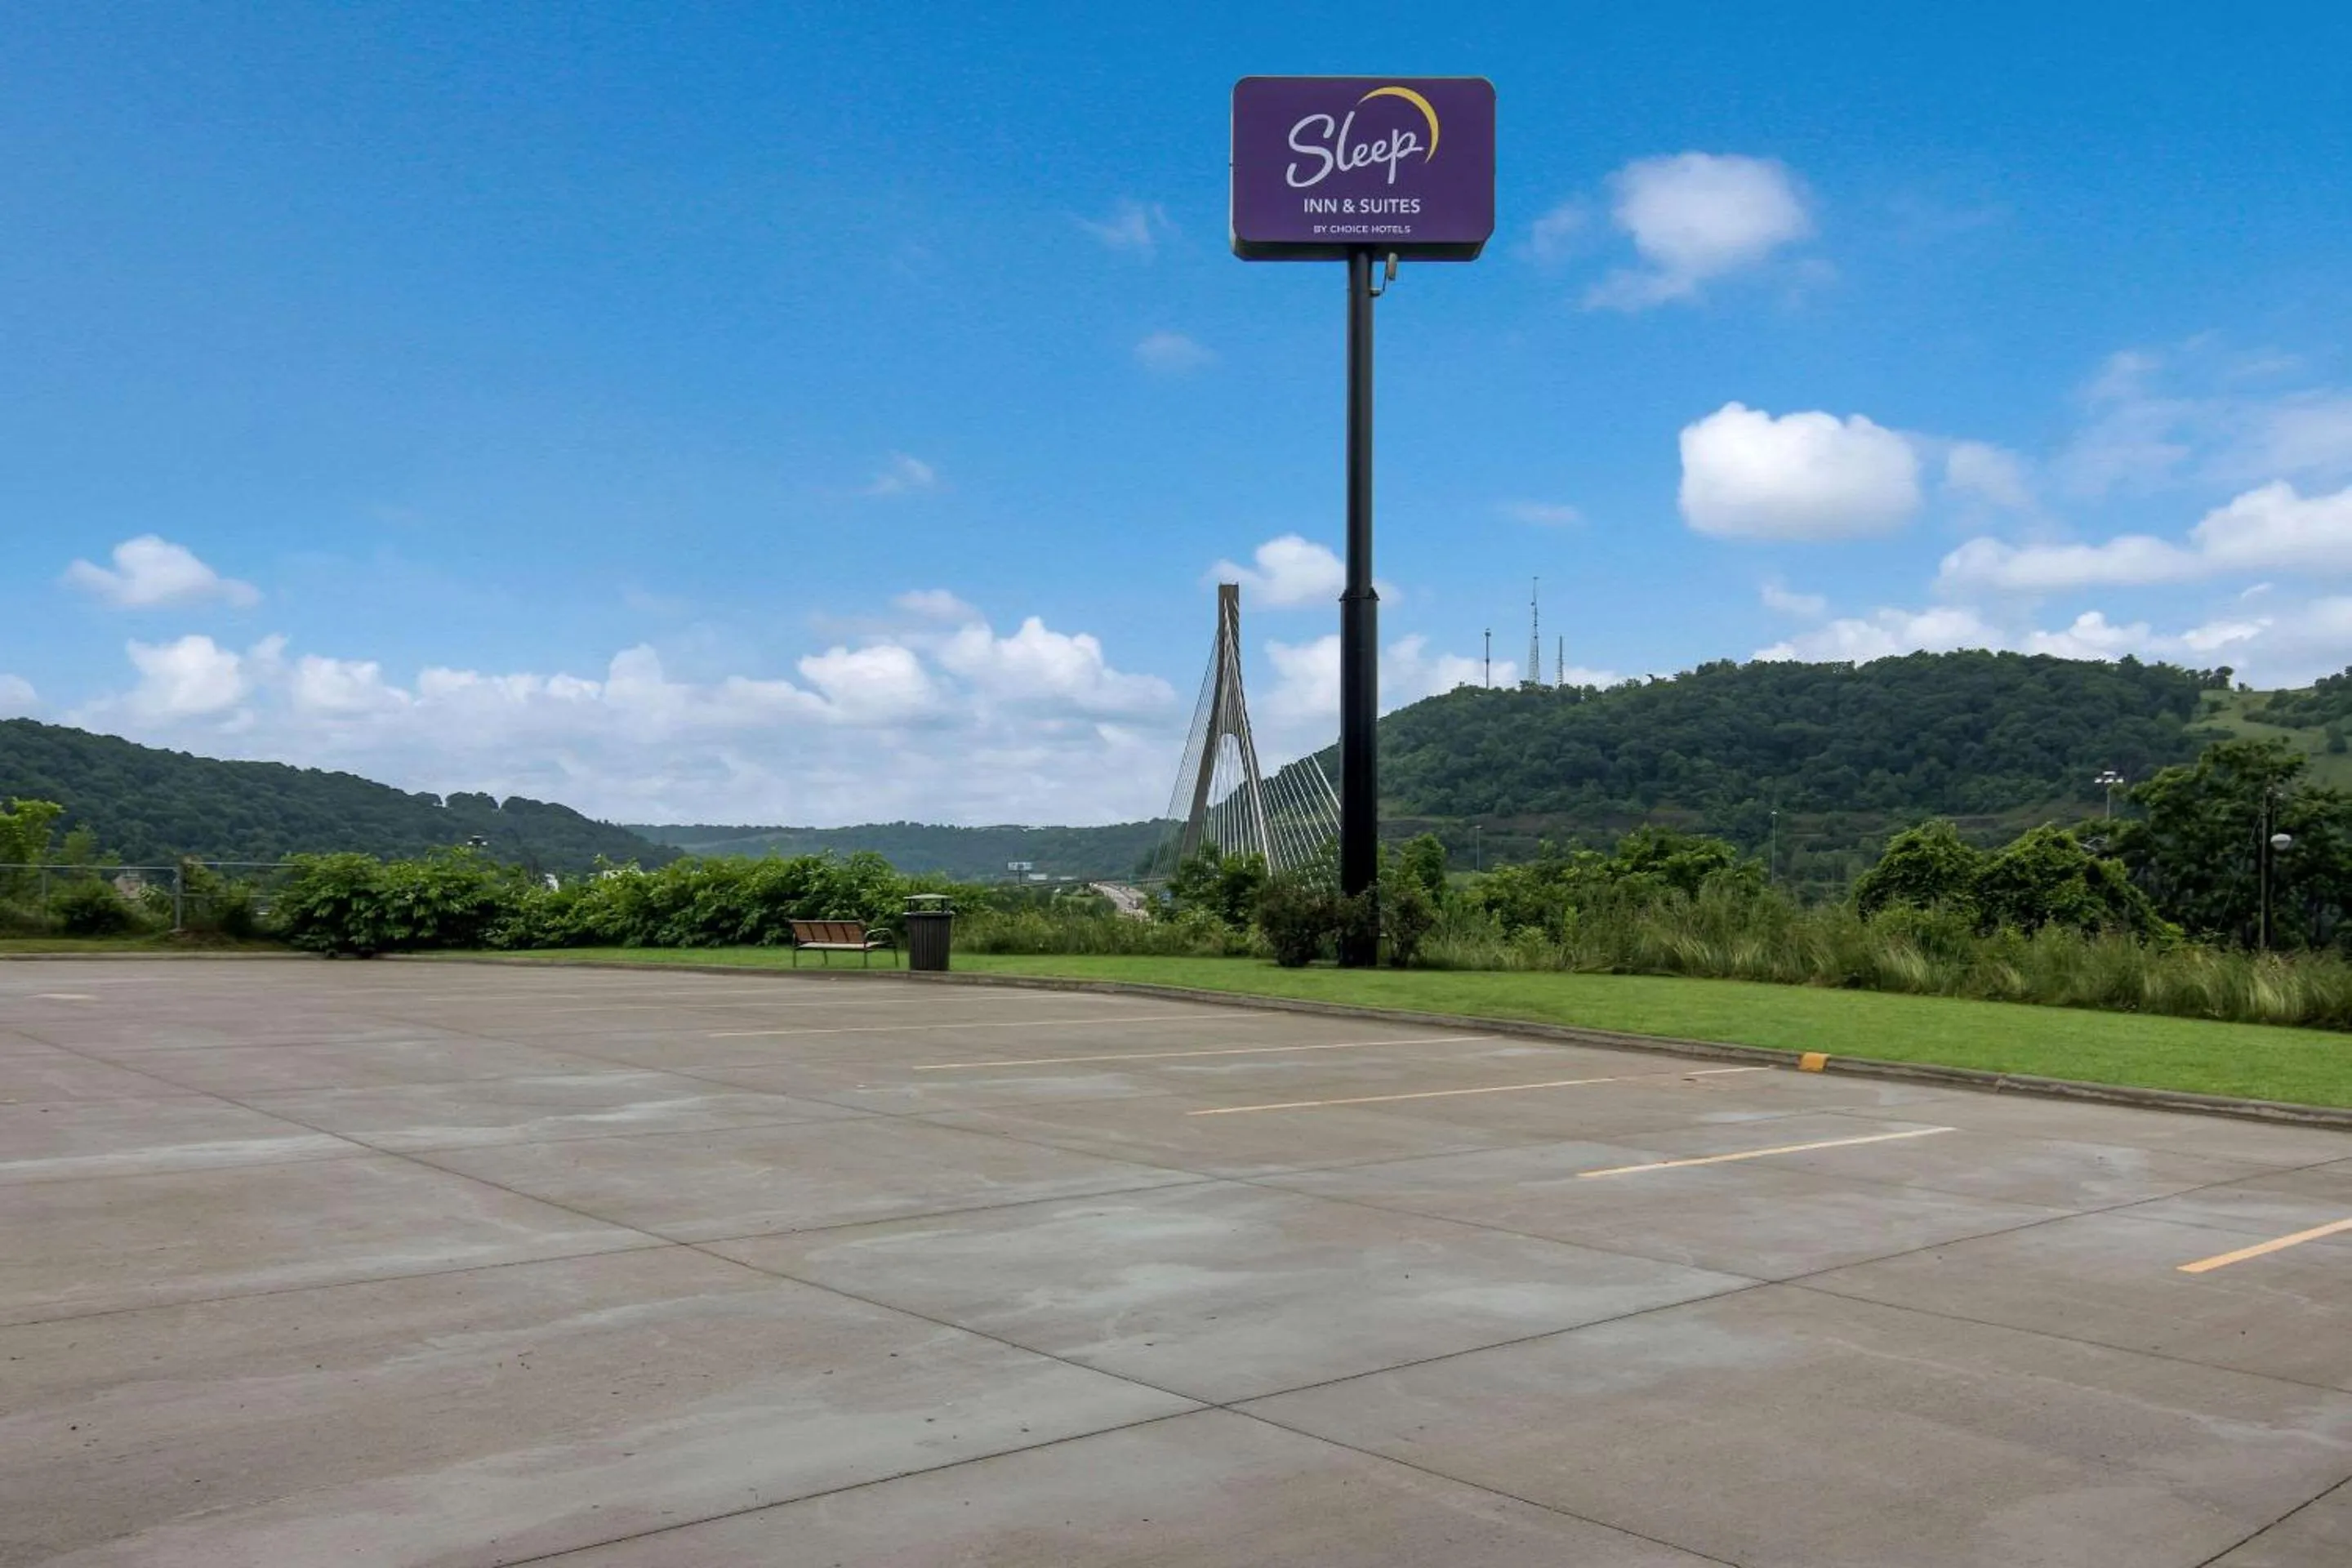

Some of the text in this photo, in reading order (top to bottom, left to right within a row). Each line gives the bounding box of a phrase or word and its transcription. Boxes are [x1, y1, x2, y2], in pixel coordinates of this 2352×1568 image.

[1285, 110, 1424, 188] Sleep
[1303, 198, 1422, 214] INN & SUITES
[1313, 225, 1411, 234] BY CHOICE HOTELS
